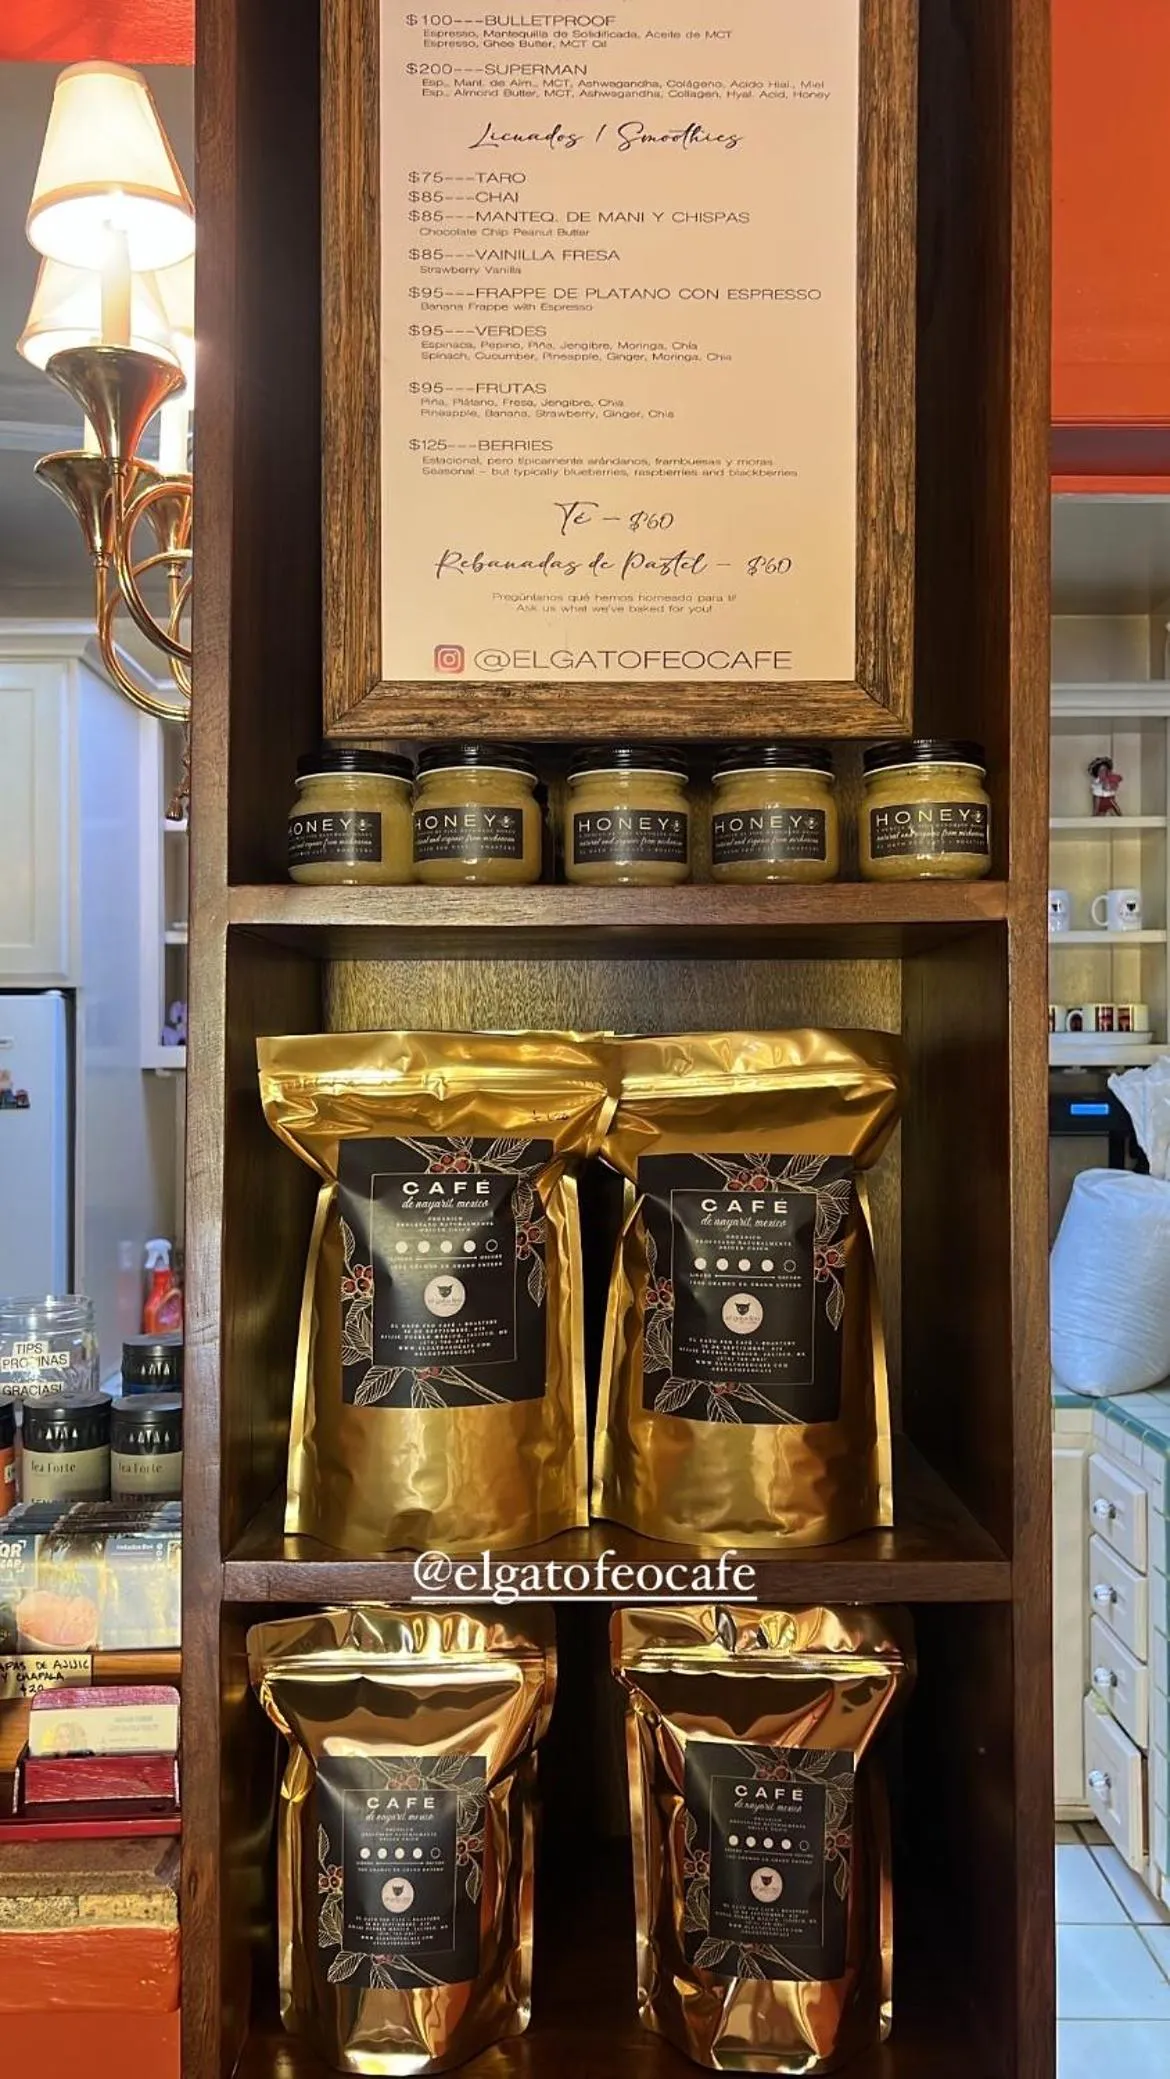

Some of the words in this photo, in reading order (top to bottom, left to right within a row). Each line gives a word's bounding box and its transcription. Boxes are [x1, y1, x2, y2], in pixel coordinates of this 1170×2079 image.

[424, 29, 478, 40] Espresso,
[483, 29, 548, 40] Mantequilla
[553, 29, 568, 40] de
[646, 29, 680, 40] Aceite
[686, 30, 700, 40] de
[706, 30, 731, 40] MCT
[424, 40, 479, 49] Espresso,
[483, 40, 515, 49] Ghee
[519, 40, 555, 49] Butter,
[560, 40, 587, 49] MCT
[592, 40, 606, 48] Oil
[489, 78, 505, 89] de
[543, 79, 573, 89] MCT,
[578, 80, 663, 89] Ashwagandha,
[801, 80, 825, 89] Miel
[454, 89, 498, 97] Almond
[503, 89, 540, 100] Butter,
[544, 89, 574, 99] MCT,
[579, 89, 664, 100] Ashwagandha,
[668, 89, 721, 100] Collagen,
[759, 90, 788, 100] Acid,
[793, 90, 830, 100] Honey
[468, 122, 583, 149] Licuados
[618, 122, 743, 152] Smoothies
[567, 211, 591, 224] DE
[598, 210, 644, 224] MANI
[652, 212, 664, 222] Y
[672, 211, 750, 224] CHISPAS
[420, 226, 477, 238] Chocolate
[482, 226, 508, 238] Chip
[513, 226, 552, 238] Peanut
[557, 226, 589, 238] Butter
[563, 248, 620, 262] FRESA
[420, 264, 481, 276] Strawberry
[483, 264, 522, 276] Vanilla
[554, 288, 579, 301] DE
[586, 288, 672, 300] PLATANO
[679, 288, 719, 301] CON
[728, 288, 821, 300] ESPRESSO
[421, 302, 463, 312] Banana
[468, 302, 509, 313] Frappe
[512, 302, 536, 312] with
[540, 302, 593, 312] Espresso
[421, 340, 476, 352] Espinaca,
[481, 340, 523, 352] Pepino,
[560, 341, 612, 352] Jengibre,
[618, 340, 666, 352] Moringa,
[422, 352, 470, 362] Spinach,
[475, 352, 534, 362] Cucumber,
[543, 352, 601, 362] Pineapple,
[607, 352, 647, 362] Ginger,
[652, 352, 701, 362] Moringa,
[453, 398, 498, 408] Plátano,
[503, 398, 537, 408] Fresa,
[541, 398, 593, 408] Jengibre,
[421, 408, 482, 419] Pineapple,
[485, 408, 531, 420] Banana,
[535, 408, 600, 420] Strawberry,
[602, 408, 643, 419] Ginger,
[423, 455, 482, 466] Estacional,
[488, 455, 513, 466] pero
[656, 456, 721, 467] frambuesas
[726, 456, 732, 467] y
[737, 456, 772, 467] moras
[423, 467, 474, 477] Seasonal
[492, 467, 509, 476] but
[514, 467, 558, 478] typically
[564, 467, 628, 479] blueberries,
[635, 467, 697, 478] raspberries
[703, 467, 724, 476] and
[729, 467, 797, 477] blackberries
[629, 510, 674, 531] $60
[435, 551, 582, 578] Rebanadas
[588, 552, 615, 576] de
[621, 550, 708, 580] Pastel
[746, 555, 792, 576] $60
[568, 592, 589, 603] qué
[595, 592, 633, 603] hemos
[639, 592, 692, 603] horneado
[698, 592, 723, 603] para
[517, 603, 536, 612] Ask
[543, 603, 556, 612] us
[561, 603, 587, 614] what
[592, 603, 624, 613] we've
[629, 603, 666, 614] baked
[668, 603, 684, 613] for
[688, 603, 712, 614] you!
[473, 648, 792, 673] @ELGATOFEOCAFE
[876, 808, 970, 827] HONEY
[579, 817, 668, 832] HONEY
[715, 815, 802, 833] HONEY
[402, 1179, 491, 1196] CAFÉ
[700, 1198, 789, 1214] CAFÉ
[16, 1342, 43, 1354] TIPS
[2, 1354, 67, 1369] PROINAS
